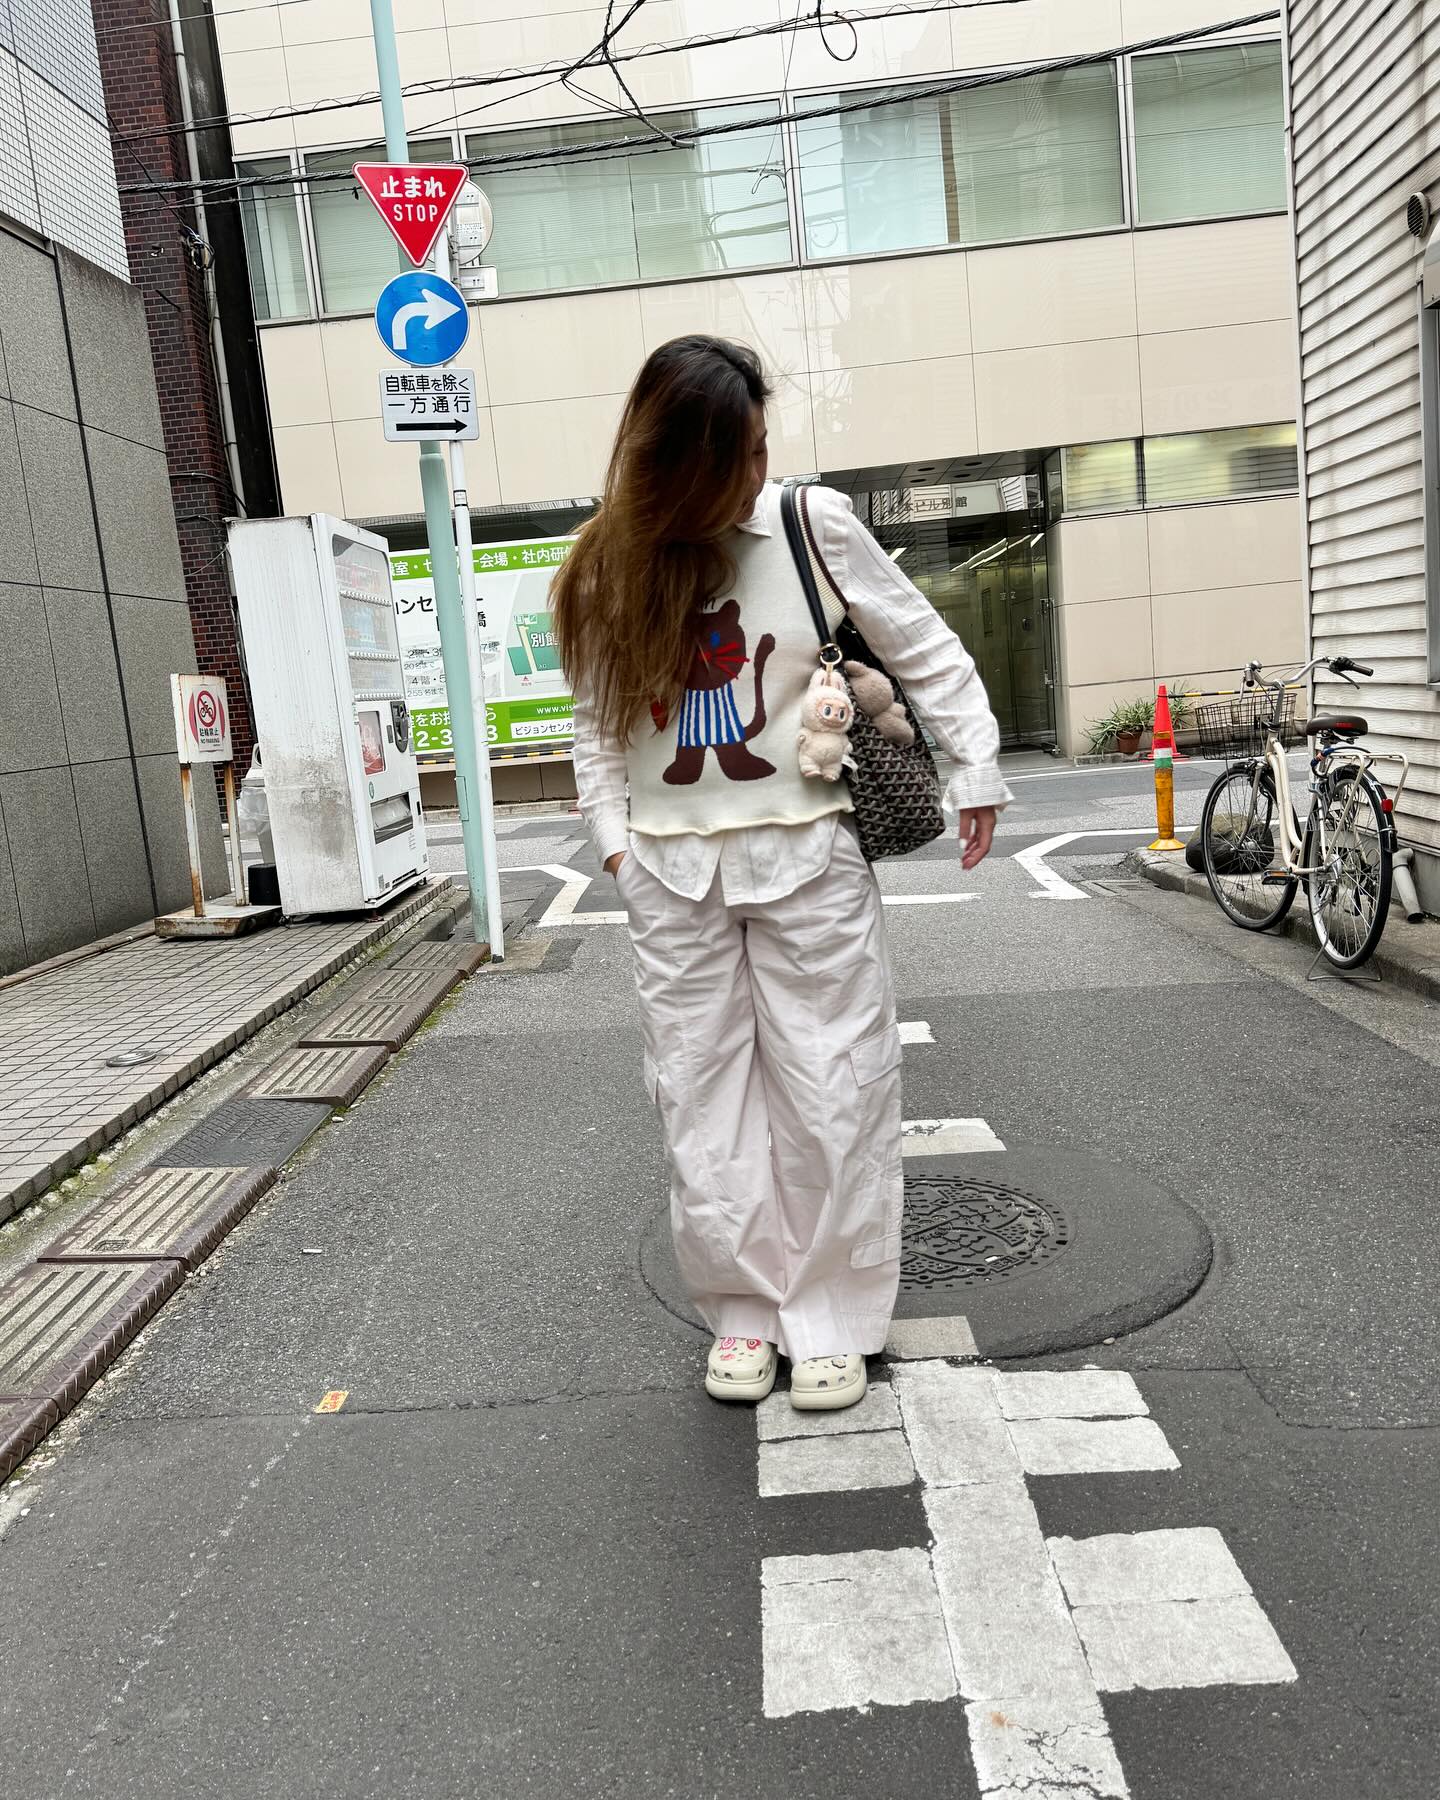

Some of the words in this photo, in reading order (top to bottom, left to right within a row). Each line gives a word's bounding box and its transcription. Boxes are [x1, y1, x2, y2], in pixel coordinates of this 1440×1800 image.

[380, 175, 447, 199] 止まれ
[393, 203, 438, 222] STOP
[385, 374, 470, 393] 自転車を除く
[387, 396, 471, 414] 一方通行
